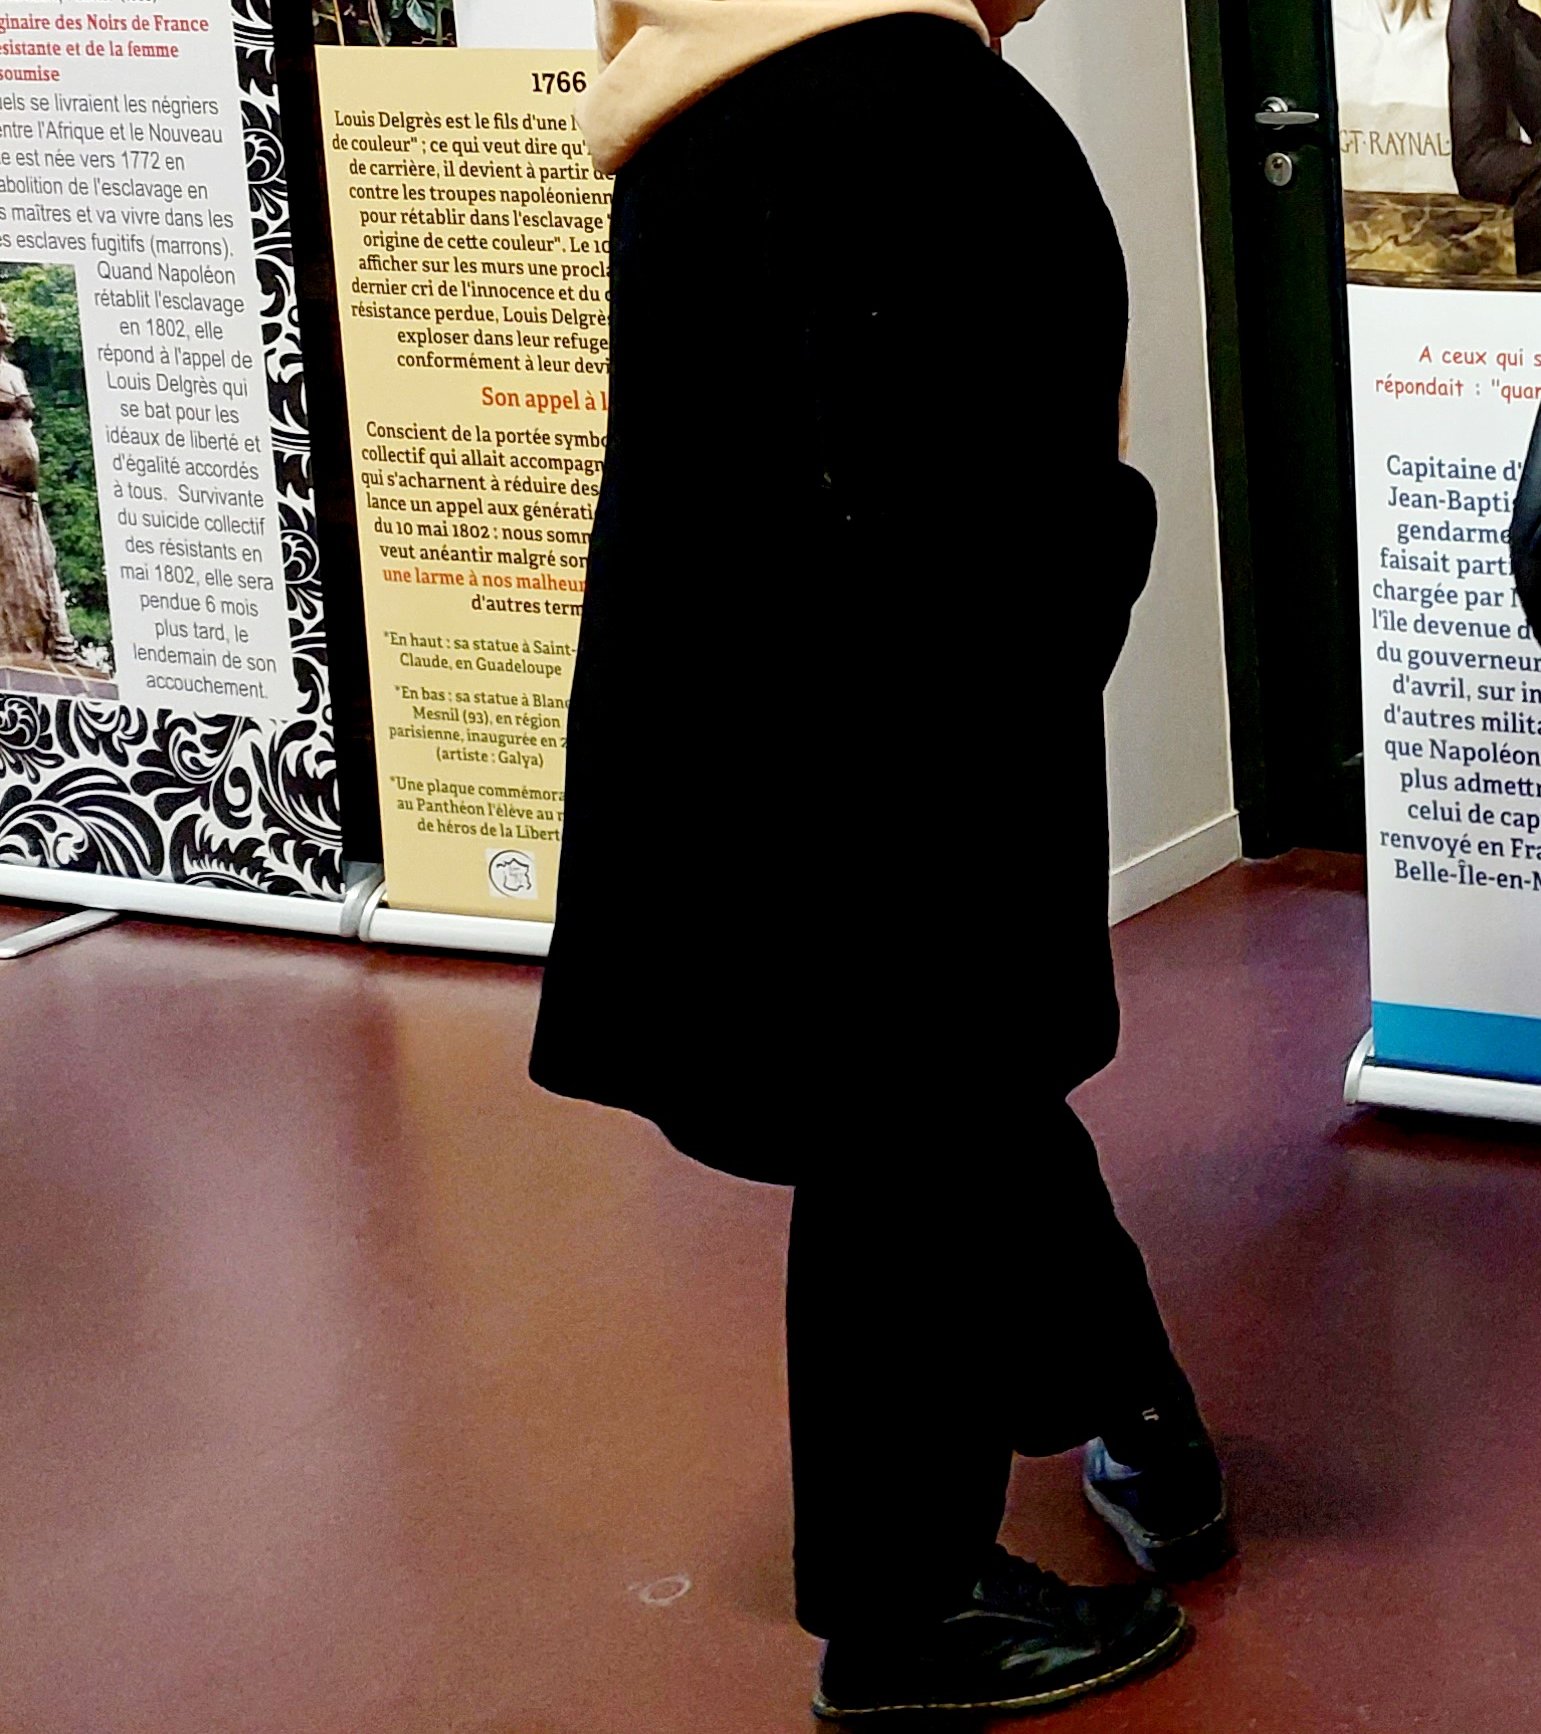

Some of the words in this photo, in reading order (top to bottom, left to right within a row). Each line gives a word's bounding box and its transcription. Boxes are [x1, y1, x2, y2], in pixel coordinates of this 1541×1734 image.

[55, 15, 82, 30] des
[87, 14, 127, 30] Noirs
[132, 15, 149, 30] de
[154, 15, 208, 31] France
[66, 43, 80, 55] et
[86, 41, 104, 56] de
[110, 41, 123, 56] la
[128, 41, 178, 57] femme
[532, 71, 586, 94] 1766
[350, 158, 366, 174] de
[370, 164, 439, 178] carrière,
[444, 161, 455, 177] il
[459, 161, 523, 178] devient
[527, 167, 536, 178] à
[539, 165, 589, 183] partir
[98, 261, 152, 280] Quand
[158, 263, 235, 286] Napoléon
[95, 290, 150, 307] rétablit
[155, 291, 244, 317] l'esclavage
[120, 322, 140, 335] en
[147, 318, 189, 340] 1802,
[195, 321, 223, 339] elle
[398, 328, 469, 347] exploser
[474, 329, 513, 346] dans
[517, 330, 549, 347] leur
[554, 332, 609, 356] refuge
[1420, 346, 1431, 362] A
[1443, 351, 1486, 364] ceux
[1497, 348, 1522, 371] qui
[482, 387, 520, 407] Son
[526, 390, 580, 414] appel
[585, 397, 596, 410] à
[140, 593, 200, 611] pendue
[206, 595, 215, 612] 6
[221, 601, 258, 616] mois
[134, 643, 216, 666] lendemain
[223, 651, 241, 669] de
[247, 657, 276, 672] son
[400, 653, 452, 670] Claude,
[456, 660, 473, 670] en
[476, 657, 561, 678] Guadeloupe
[413, 706, 459, 721] Mesnil
[496, 715, 512, 724] en
[515, 713, 560, 730] région
[1385, 704, 1475, 730] d'autres
[1408, 801, 1461, 821] celui
[1469, 804, 1494, 824] de
[1381, 832, 1471, 858] renvoyé
[1478, 841, 1504, 856] en
